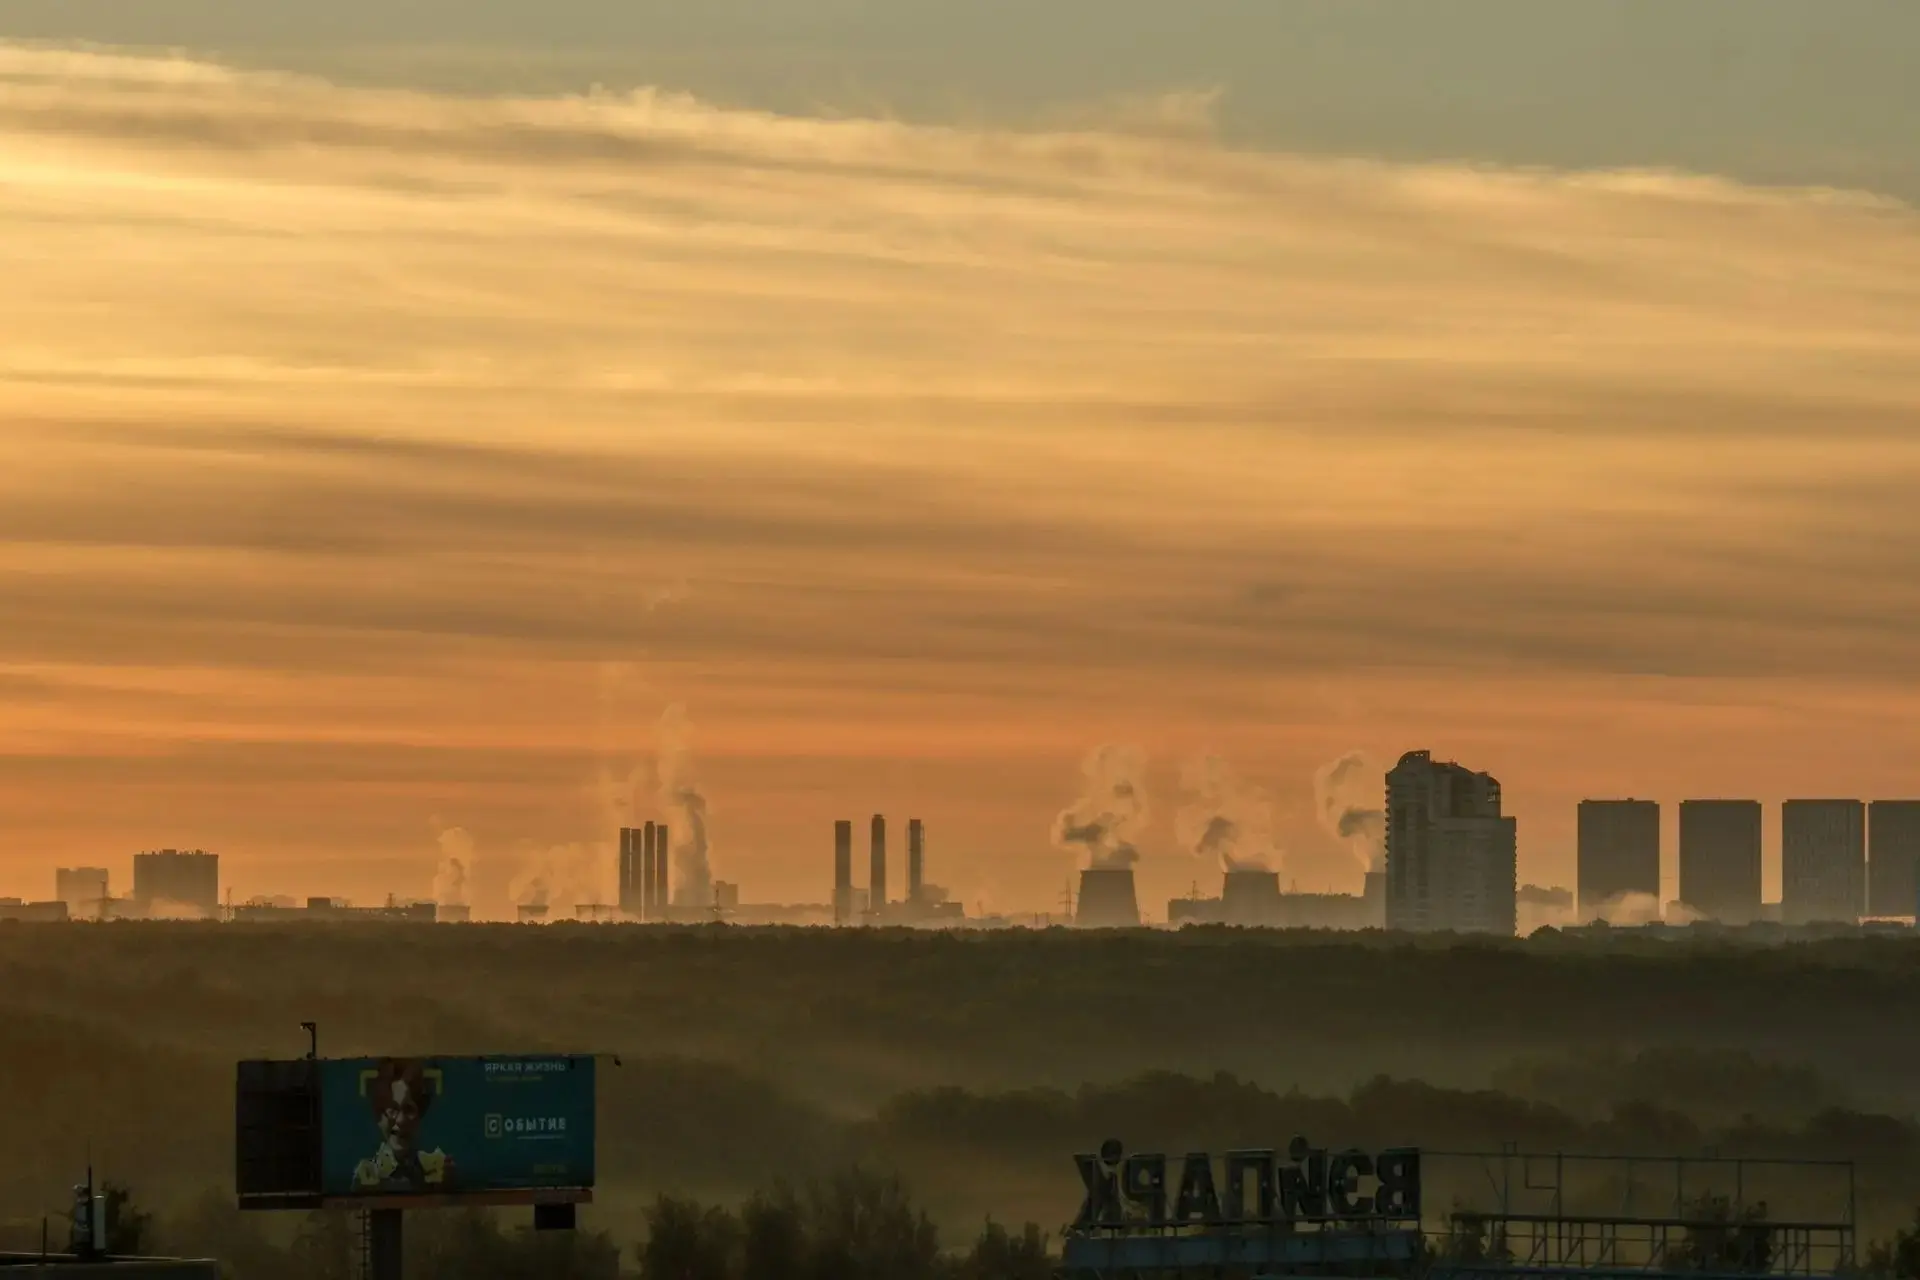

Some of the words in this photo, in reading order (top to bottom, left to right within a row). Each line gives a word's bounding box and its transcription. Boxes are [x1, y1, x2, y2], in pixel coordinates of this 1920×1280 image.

[485, 1063, 521, 1073] ЯРКАЯ
[525, 1062, 566, 1072] ЖИЗНЬ
[488, 1117, 566, 1132] СОБЫТИЕ
